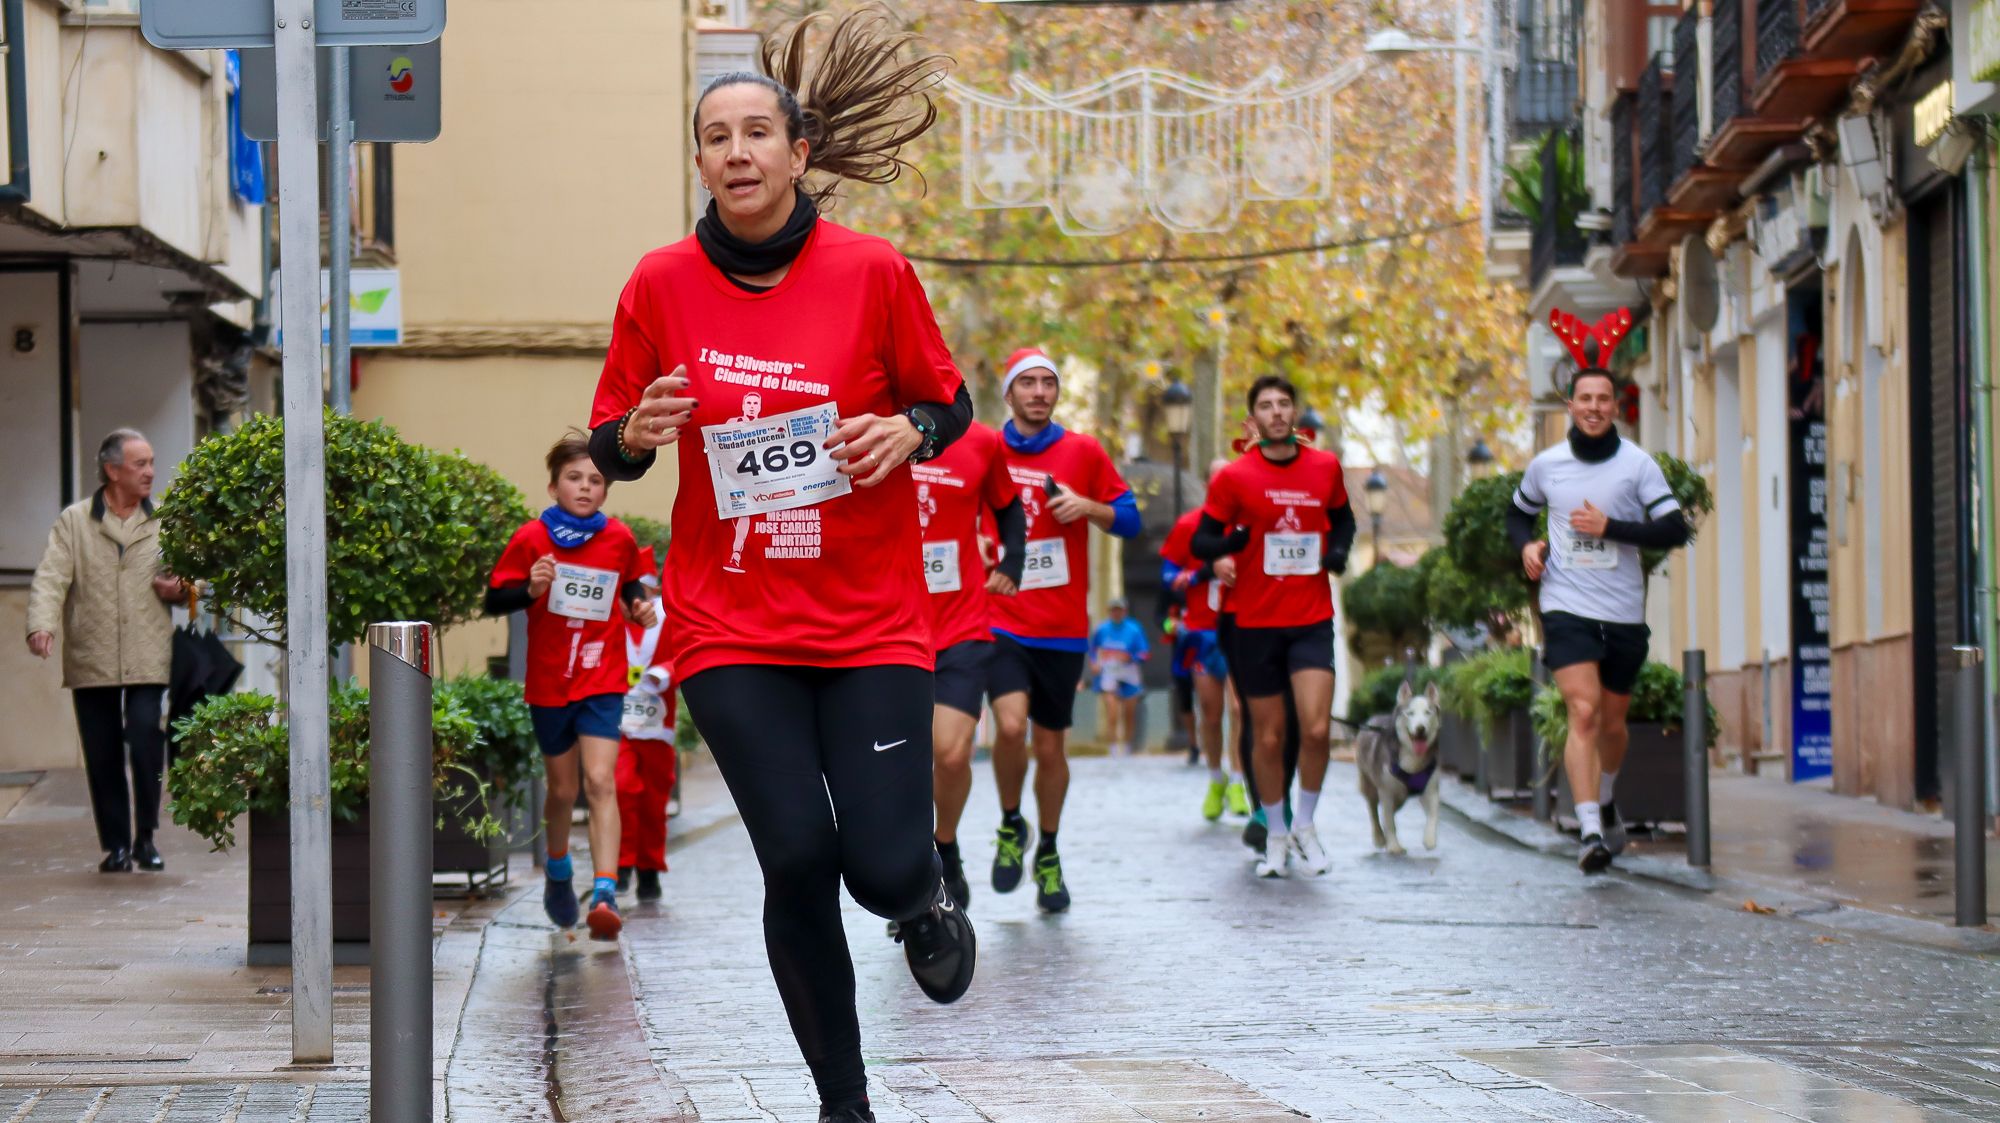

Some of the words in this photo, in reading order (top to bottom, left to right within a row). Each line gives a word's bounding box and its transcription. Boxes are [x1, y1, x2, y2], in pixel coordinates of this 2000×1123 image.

[15, 328, 35, 353] 8
[699, 347, 708, 362] I
[709, 350, 734, 367] San
[735, 355, 793, 375] Silvestre
[714, 367, 761, 387] Ciudad
[762, 374, 780, 390] de
[781, 376, 830, 396] Lucena
[717, 434, 732, 442] San
[733, 428, 767, 440] Silvestre
[719, 441, 745, 450] Ciudad
[746, 438, 756, 446] de
[758, 432, 785, 443] Lucena
[737, 440, 816, 476] 469
[802, 479, 836, 491] enerplus
[766, 509, 821, 521] MEMORIAL
[755, 522, 779, 534] JOSE
[780, 521, 821, 534] CARLOS
[772, 534, 822, 546] HURTADO
[1572, 541, 1605, 552] 254
[764, 547, 821, 558] MARJALIZO
[1278, 547, 1306, 559] 119
[565, 582, 604, 600] 638
